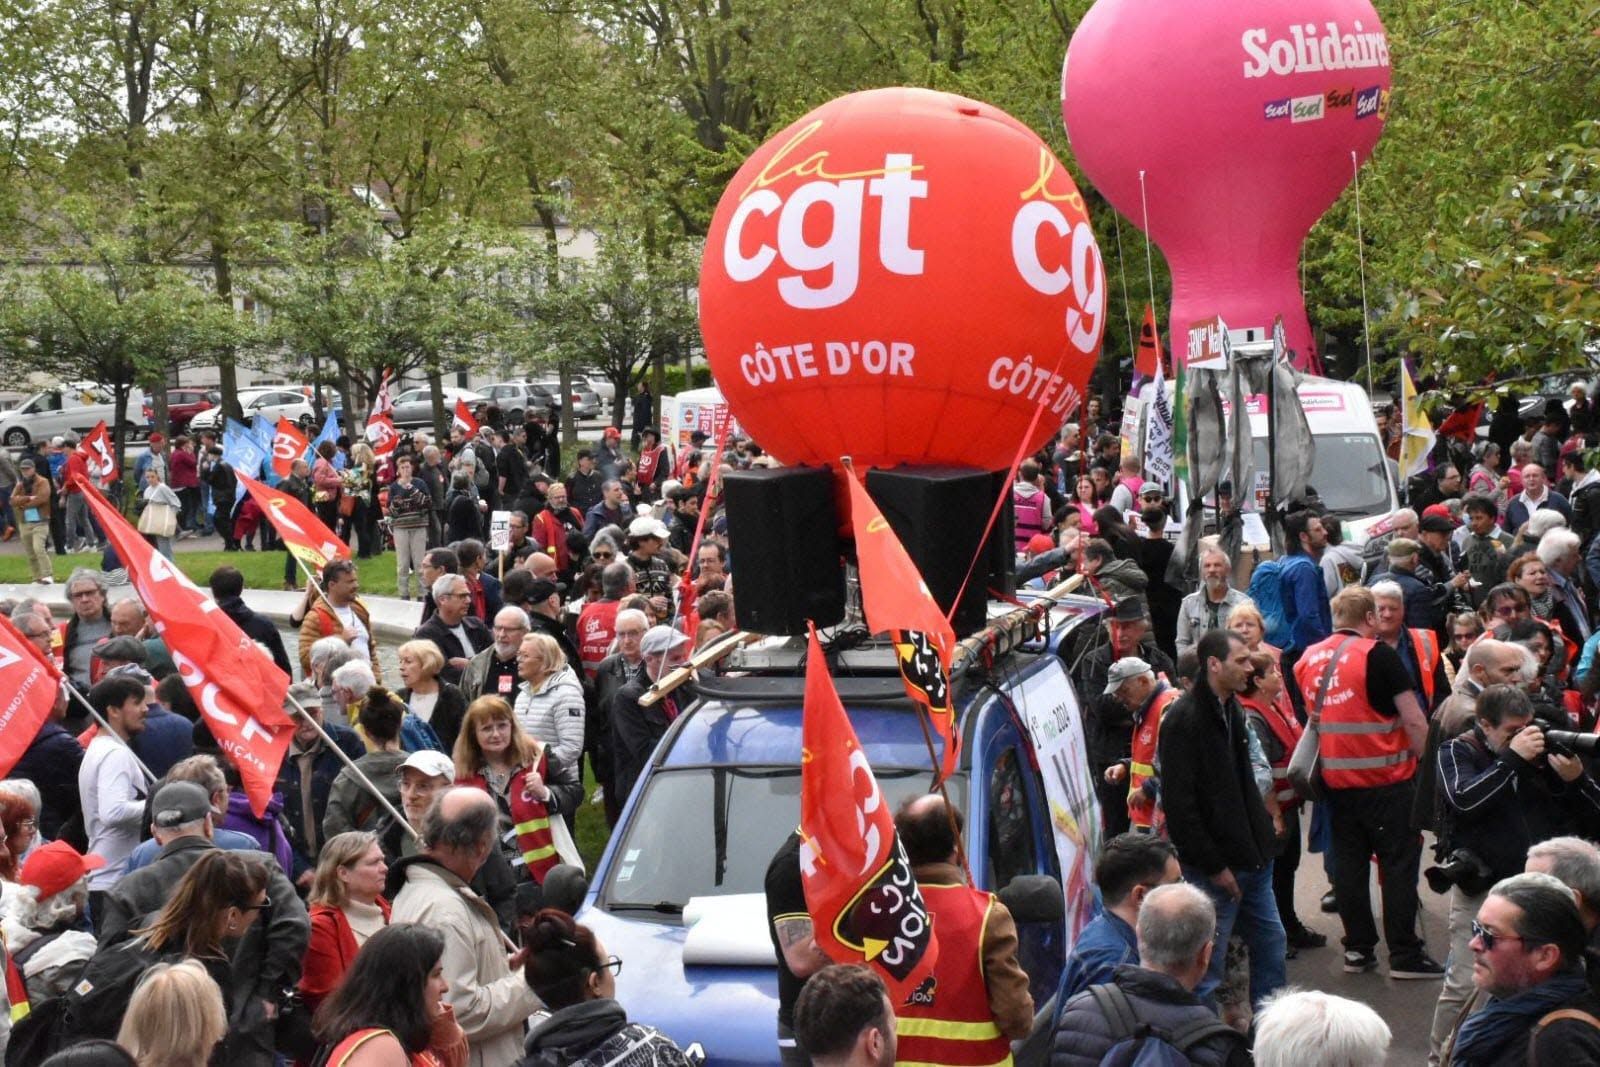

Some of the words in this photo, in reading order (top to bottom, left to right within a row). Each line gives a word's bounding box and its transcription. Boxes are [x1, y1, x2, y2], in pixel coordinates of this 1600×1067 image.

[723, 153, 929, 310] cgt
[740, 342, 819, 387] CÔTE
[825, 340, 915, 377] D'OR
[988, 354, 1064, 406] CÔTE
